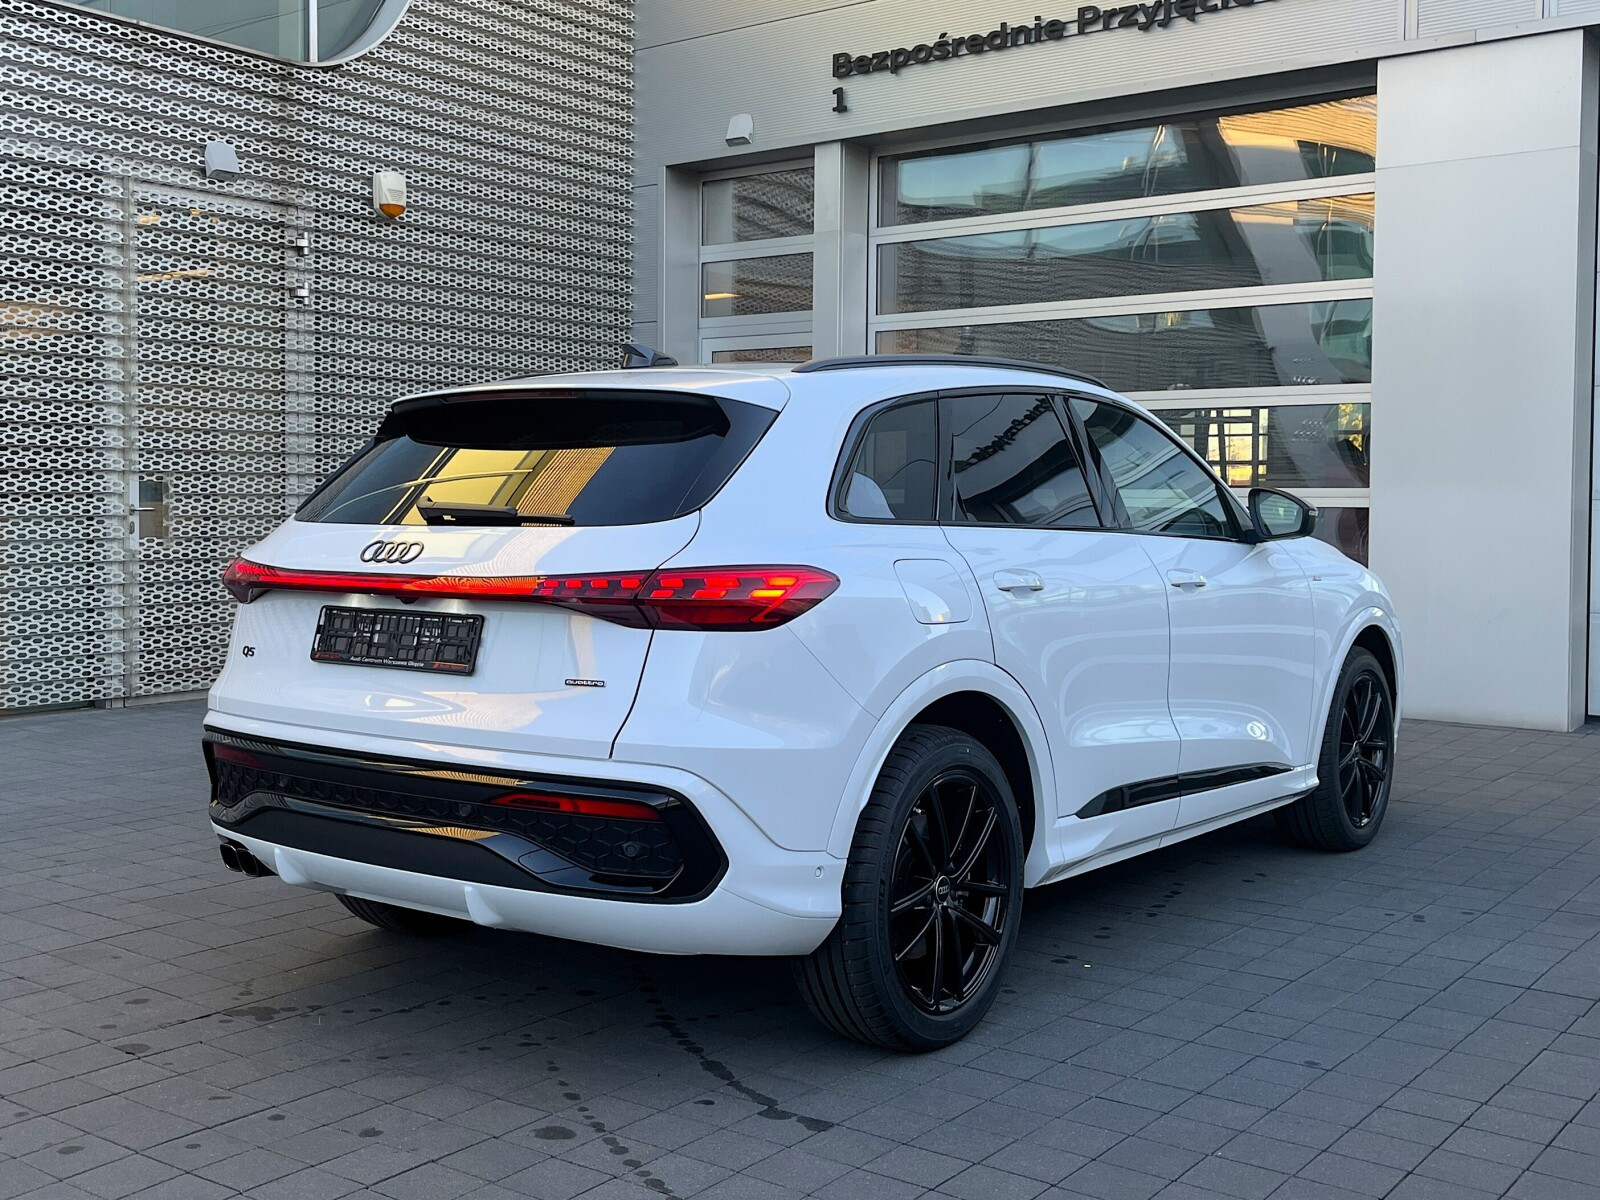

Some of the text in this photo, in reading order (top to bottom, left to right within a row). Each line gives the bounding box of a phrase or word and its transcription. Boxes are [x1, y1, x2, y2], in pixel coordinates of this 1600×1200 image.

[832, 15, 1065, 78] Bezpośrednie
[832, 87, 848, 113] 1
[242, 645, 256, 658] Q5
